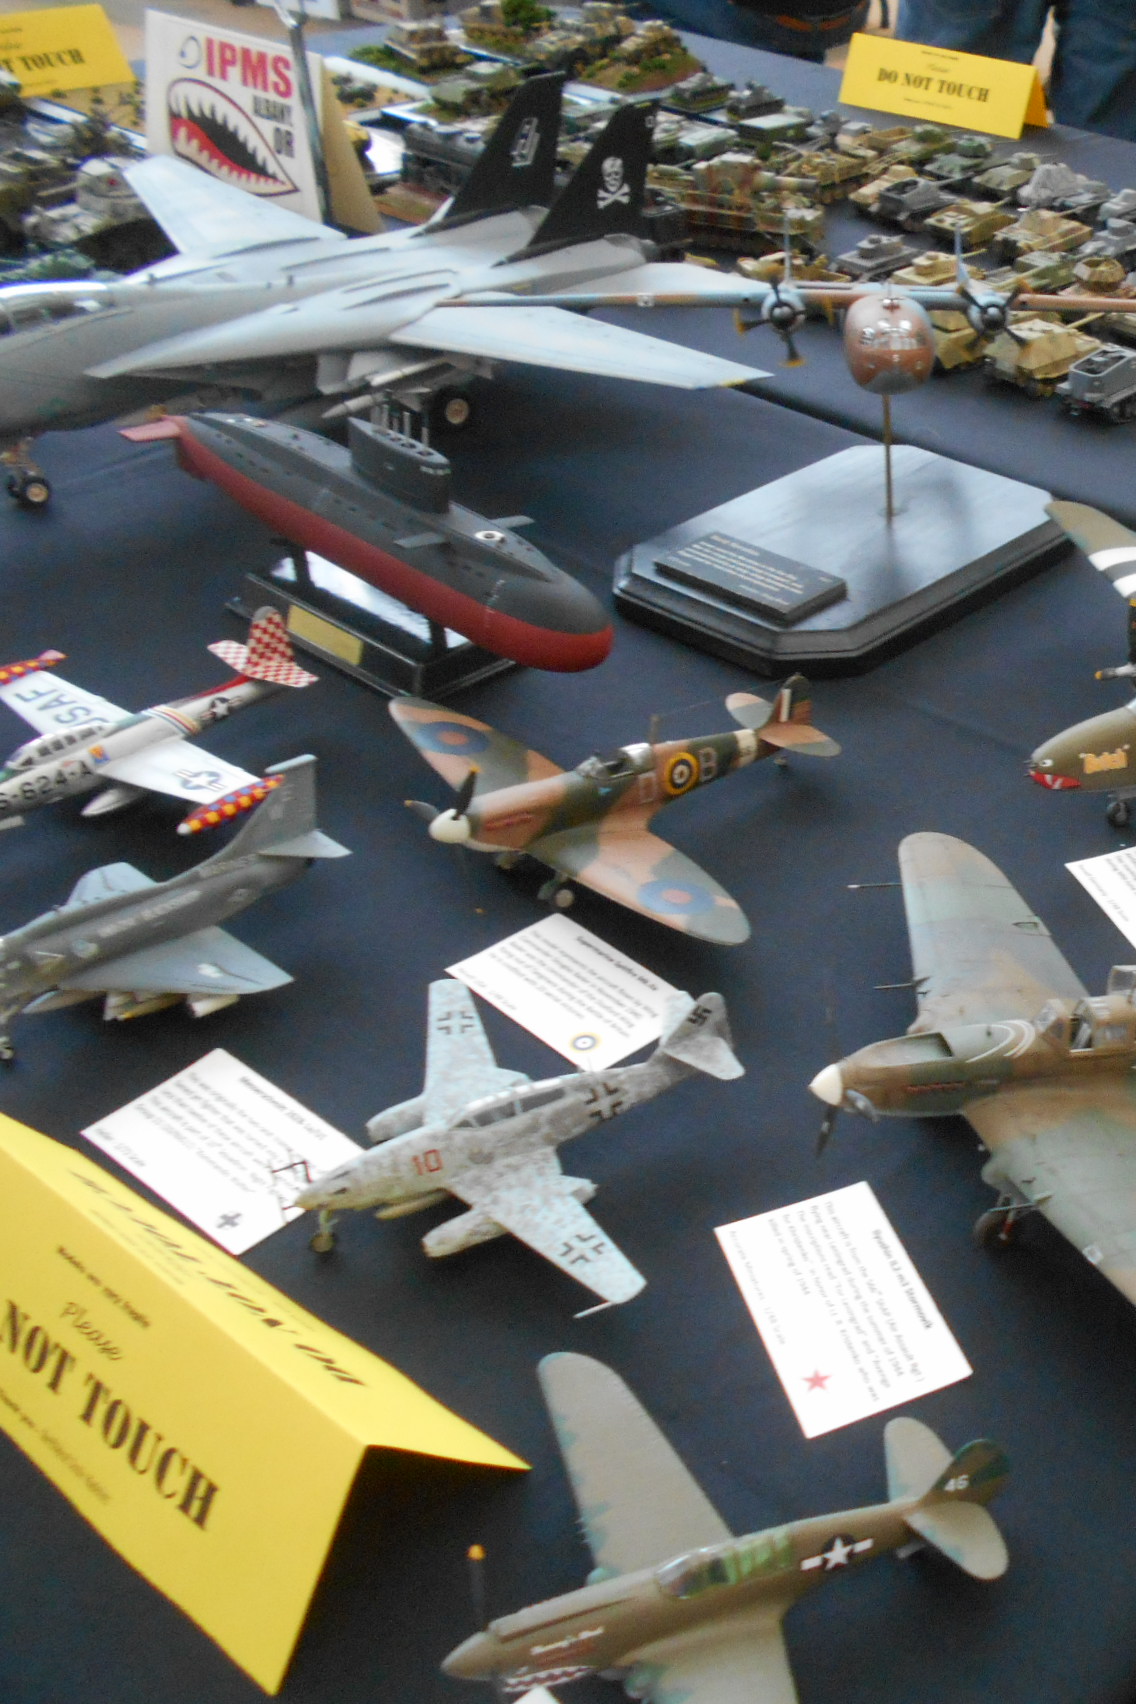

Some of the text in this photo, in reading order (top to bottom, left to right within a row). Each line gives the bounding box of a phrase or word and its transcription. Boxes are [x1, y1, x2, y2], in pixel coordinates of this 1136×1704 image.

[18, 48, 85, 72] TOUCH
[205, 36, 293, 98] IPMS
[876, 67, 898, 84] DO
[902, 73, 935, 91] NOT
[937, 79, 990, 103] TOUCH
[411, 1149, 444, 1177] 10
[60, 1301, 123, 1362] Please
[0, 1303, 76, 1397] NOT
[82, 1373, 219, 1532] TOUCH
